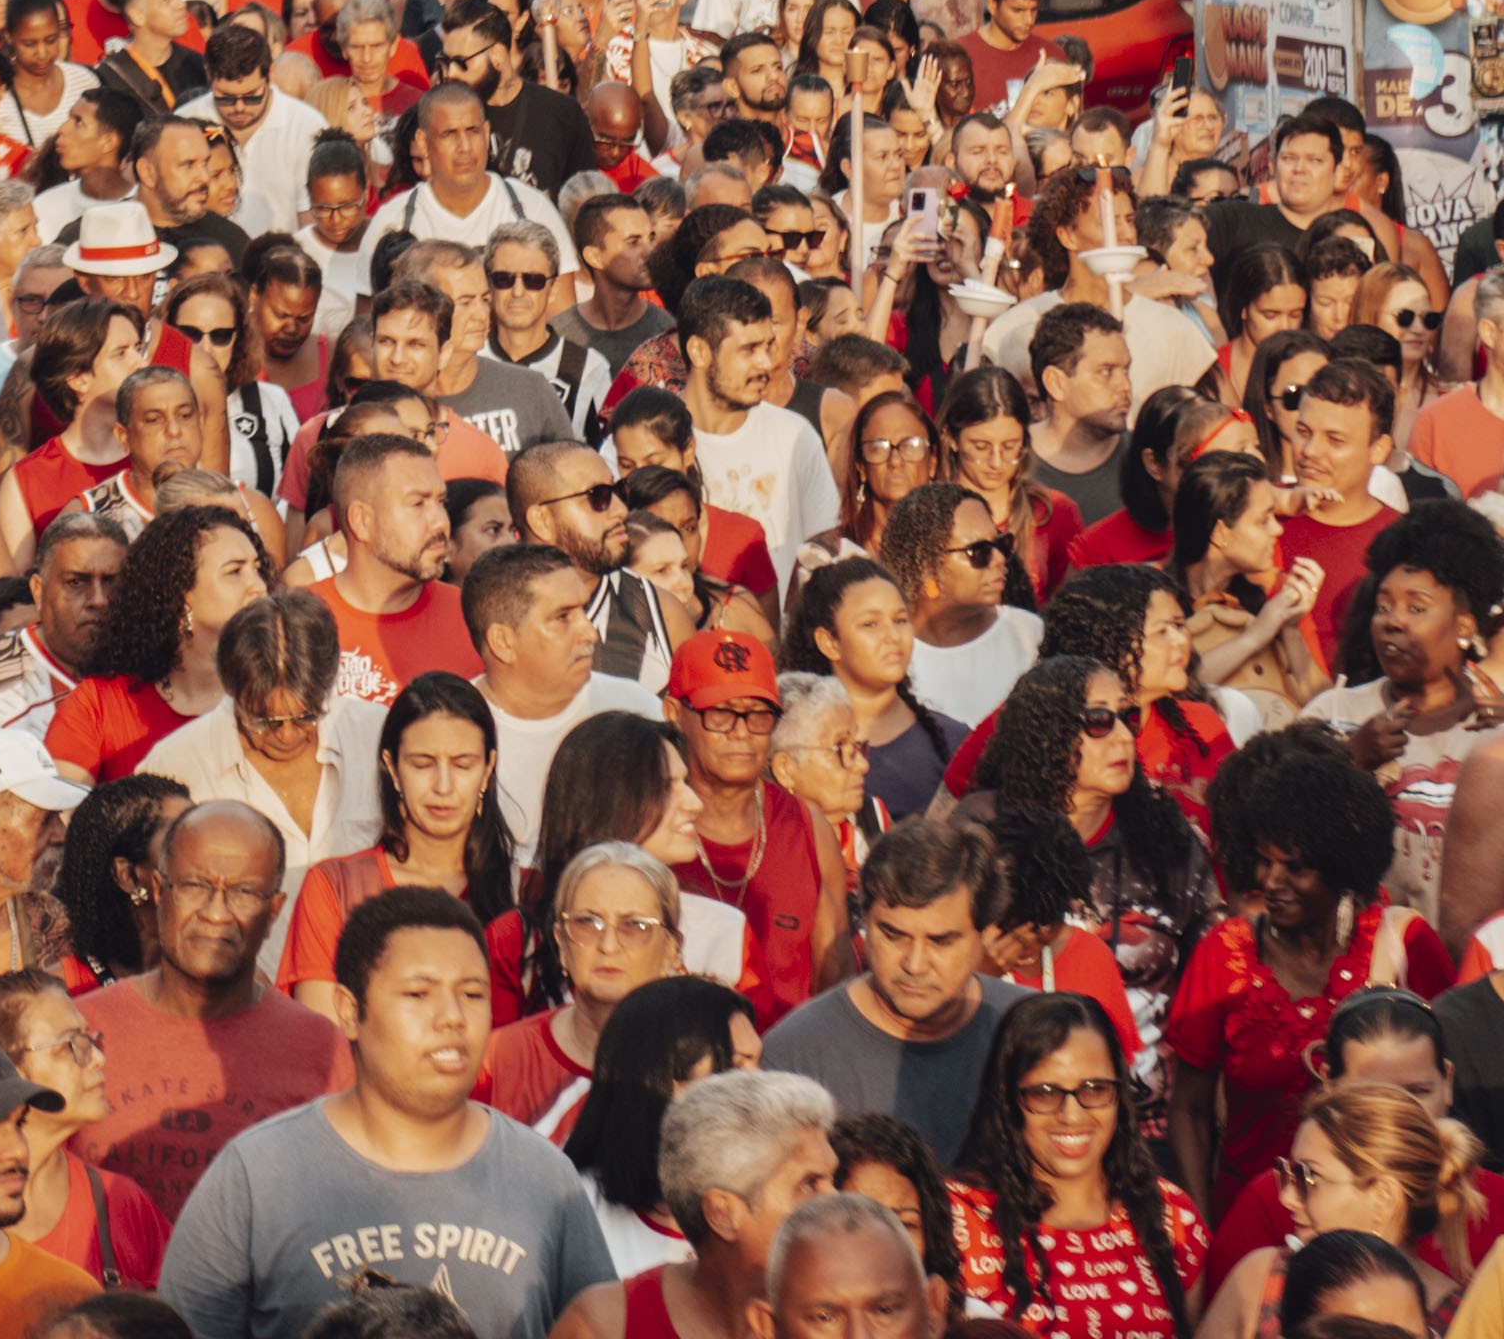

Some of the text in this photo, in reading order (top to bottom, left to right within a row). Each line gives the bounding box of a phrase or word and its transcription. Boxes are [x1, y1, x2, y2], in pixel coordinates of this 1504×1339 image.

[1304, 45, 1327, 90] 200
[1376, 94, 1413, 117] DE
[310, 1222, 528, 1281] FREE SPIRIT
